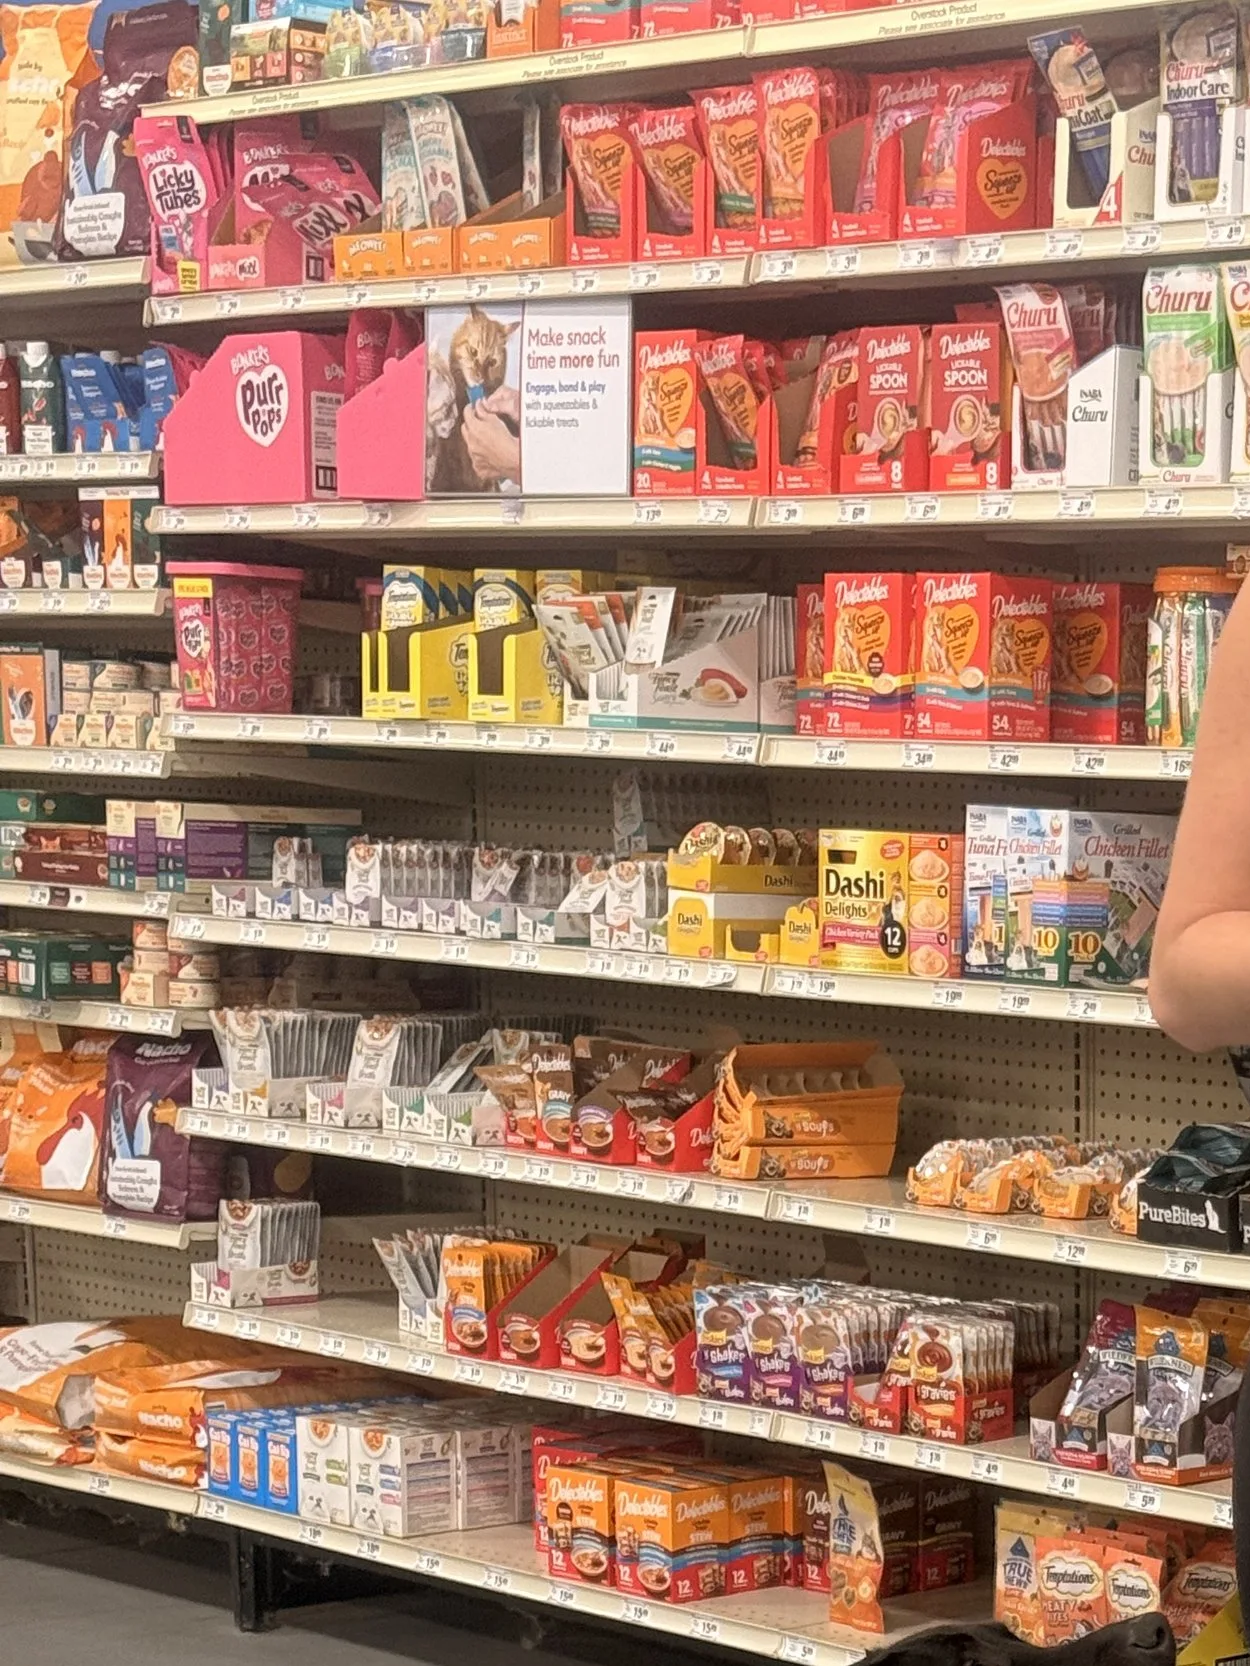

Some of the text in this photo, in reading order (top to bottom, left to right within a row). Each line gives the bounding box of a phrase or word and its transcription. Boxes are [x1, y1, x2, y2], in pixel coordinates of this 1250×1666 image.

[1166, 60, 1205, 81] Churu
[1166, 79, 1230, 98] Indoor Care
[981, 137, 1027, 158] Delectables
[152, 168, 196, 192] Licky
[156, 190, 201, 210] Tubes
[1103, 190, 1117, 215] 4
[1146, 285, 1212, 314] Churu
[1006, 302, 1060, 328] Churu
[528, 326, 607, 346] Make snack
[939, 330, 991, 360] Delectables
[639, 342, 692, 372] Delectables
[866, 335, 912, 363] Delectables
[231, 345, 270, 376] BONKERS
[527, 350, 620, 370] time more fun
[525, 382, 606, 395] Engage, bond & play
[869, 372, 908, 390] SPOON
[944, 370, 987, 387] SPOON
[525, 398, 598, 413] with squeezables &
[1071, 404, 1108, 424] Churu
[525, 416, 579, 428] lickable treats
[891, 461, 902, 481] 8
[985, 462, 997, 482] 8
[834, 577, 889, 607] Delectables
[923, 575, 978, 605] Delectables
[991, 595, 1049, 620] Delectables
[826, 711, 843, 731] 72
[916, 711, 931, 729] 54
[992, 713, 1009, 732] 54
[1113, 823, 1142, 836] Grilled
[1009, 839, 1063, 856] Chicken Fillet
[1084, 836, 1169, 859] Chicken Fillet
[763, 873, 794, 890] Dashi
[823, 868, 885, 900] Dashi
[677, 912, 703, 927] Dashi
[825, 901, 868, 920] Delights
[788, 920, 812, 935] Dashi
[885, 926, 902, 947] 12
[1033, 926, 1057, 949] 10
[1071, 931, 1099, 954] 10
[1138, 1201, 1206, 1228] PureBites
[710, 1346, 746, 1364] Shakes
[759, 1355, 791, 1374] Shakes
[811, 1366, 846, 1383] Shakes
[549, 1475, 604, 1503] Delectables
[732, 1485, 780, 1512] Delectables
[617, 1490, 670, 1517] Delectables
[675, 1495, 727, 1522] Delectables
[576, 1515, 598, 1529] STEW
[551, 1548, 565, 1566] 12
[619, 1563, 633, 1582] 12
[1002, 1562, 1034, 1582] TRUE
[1043, 1568, 1098, 1588] Temptations
[1109, 1580, 1152, 1602] Temptations
